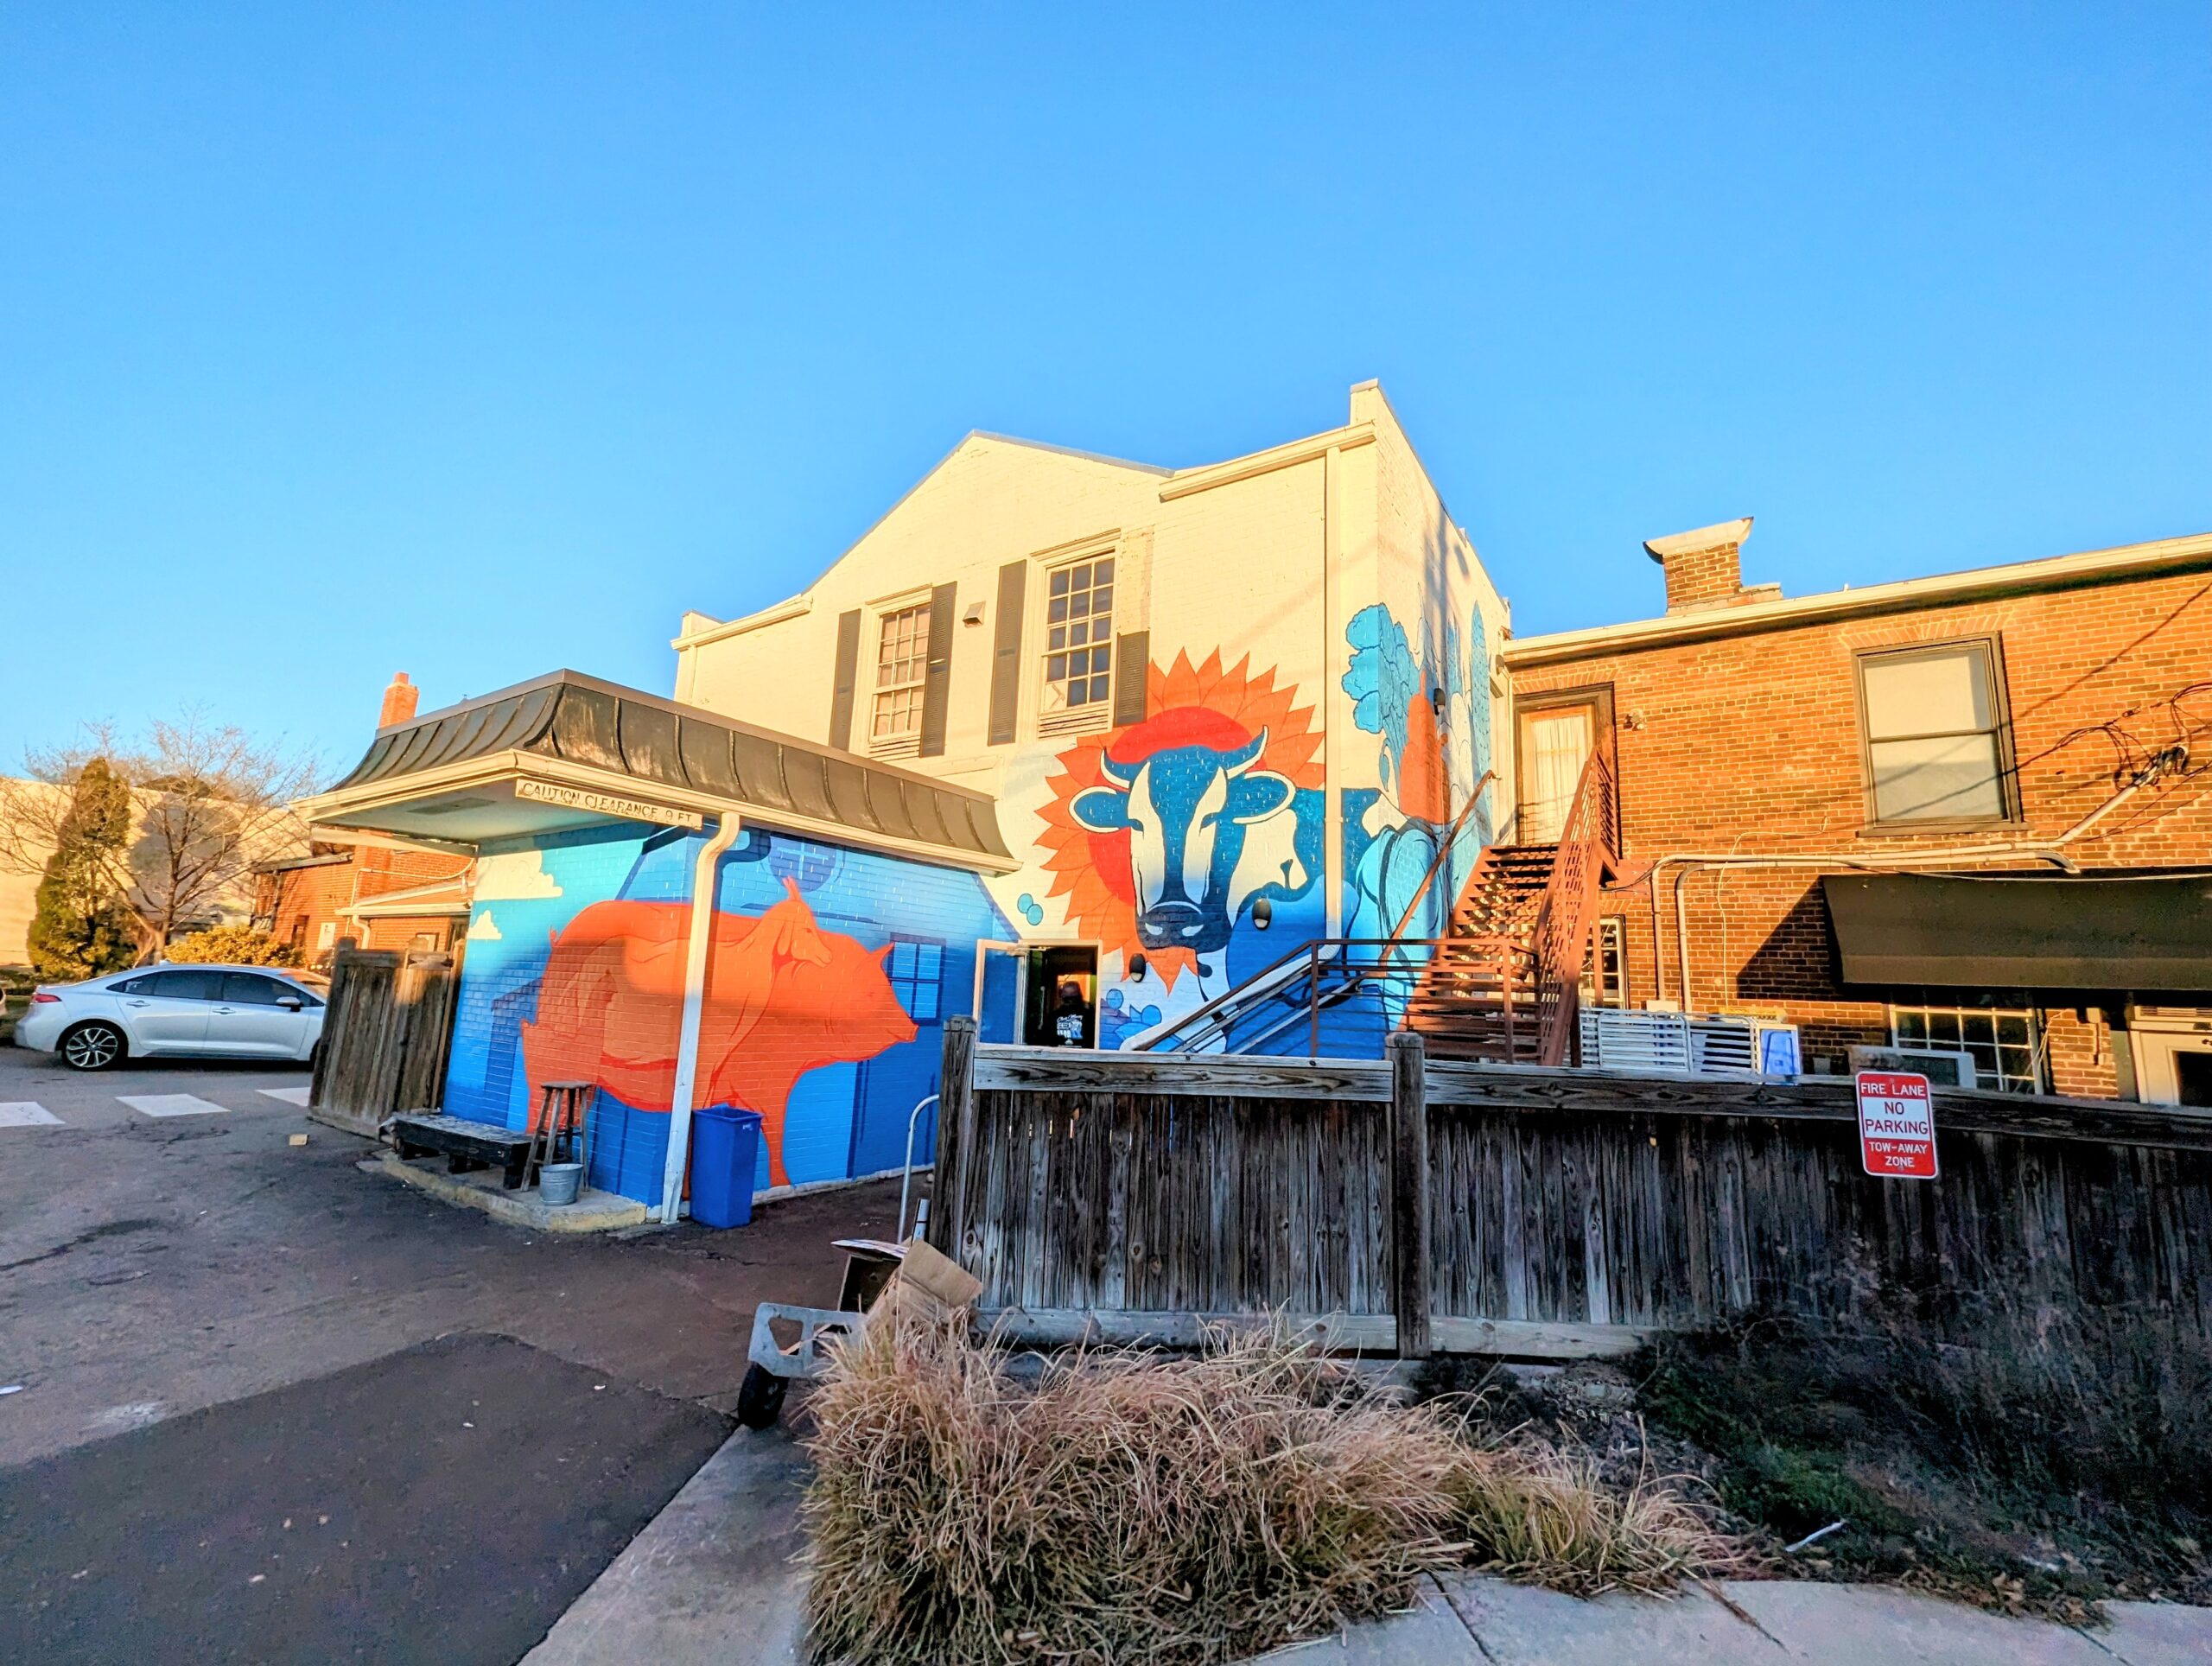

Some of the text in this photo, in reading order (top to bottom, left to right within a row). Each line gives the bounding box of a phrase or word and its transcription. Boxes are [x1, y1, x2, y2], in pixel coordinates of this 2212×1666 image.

[522, 782, 580, 804] CAUTION
[585, 794, 658, 819] CLEARANCE
[1860, 1083, 1926, 1097] FIRE LANE
[1885, 1102, 1904, 1115] NO
[1865, 1119, 1929, 1135] PARKING
[1869, 1141, 1928, 1154] TOW-AWAY
[1885, 1156, 1915, 1167] ZONE
